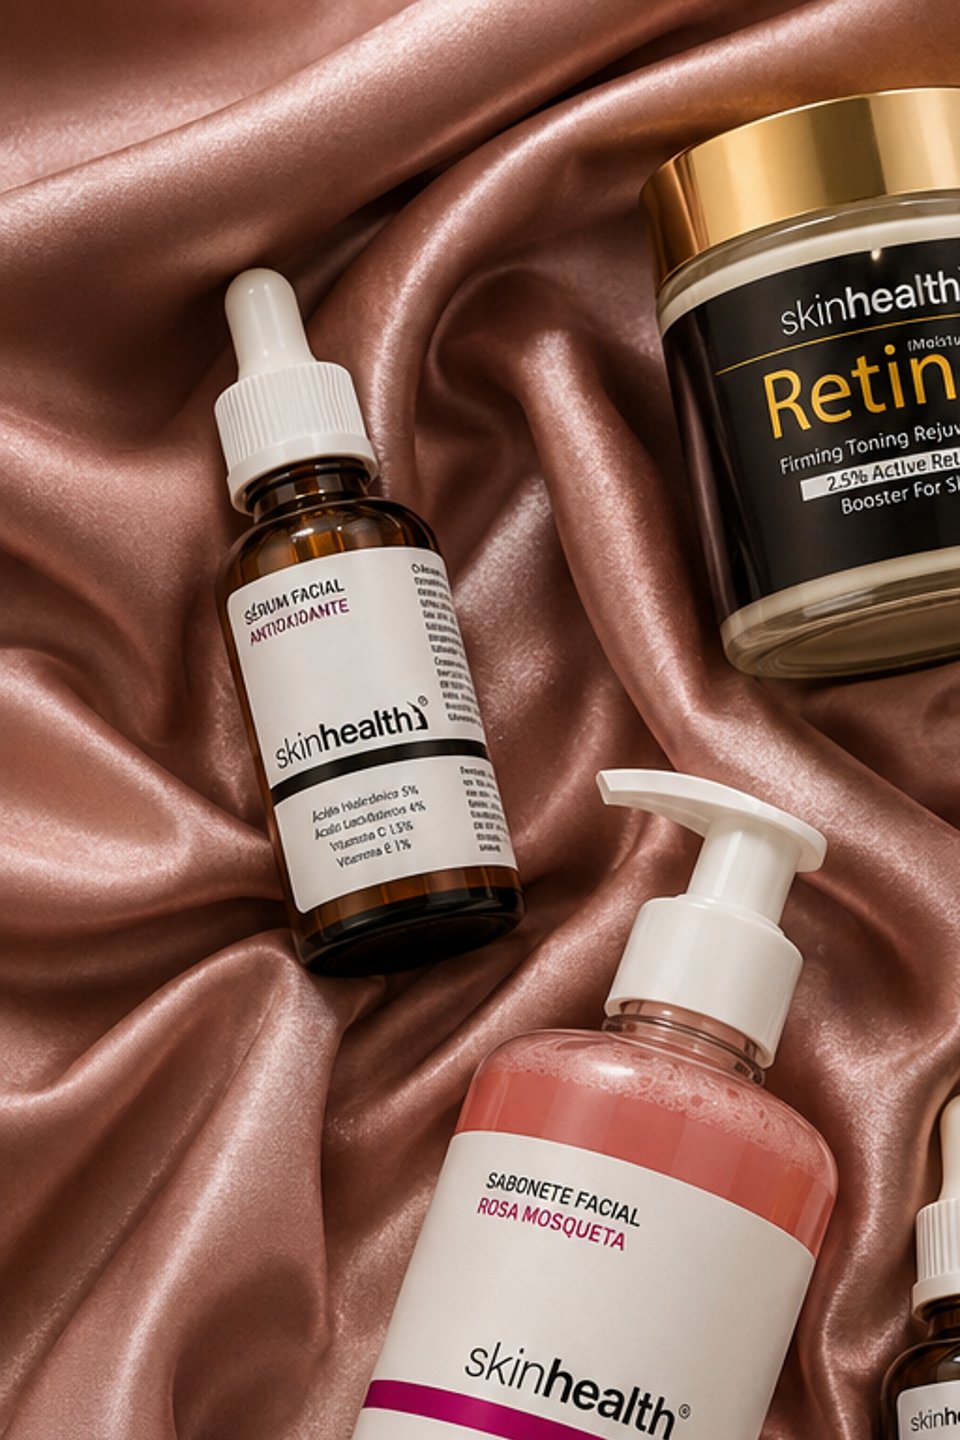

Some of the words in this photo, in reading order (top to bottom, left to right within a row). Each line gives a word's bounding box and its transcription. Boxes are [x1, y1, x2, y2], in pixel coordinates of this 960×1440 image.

[780, 447, 843, 475] Firming
[845, 432, 909, 455] Toning
[826, 469, 868, 492] 2.5%
[872, 455, 927, 482] Active
[841, 487, 908, 515] Booster
[914, 480, 940, 498] For
[290, 579, 345, 605] FACIAL
[486, 1171, 574, 1205] SABONETE
[574, 1192, 641, 1227] FACIAL
[477, 1197, 519, 1221] ROSA
[521, 1205, 626, 1251] MOSQUETA
